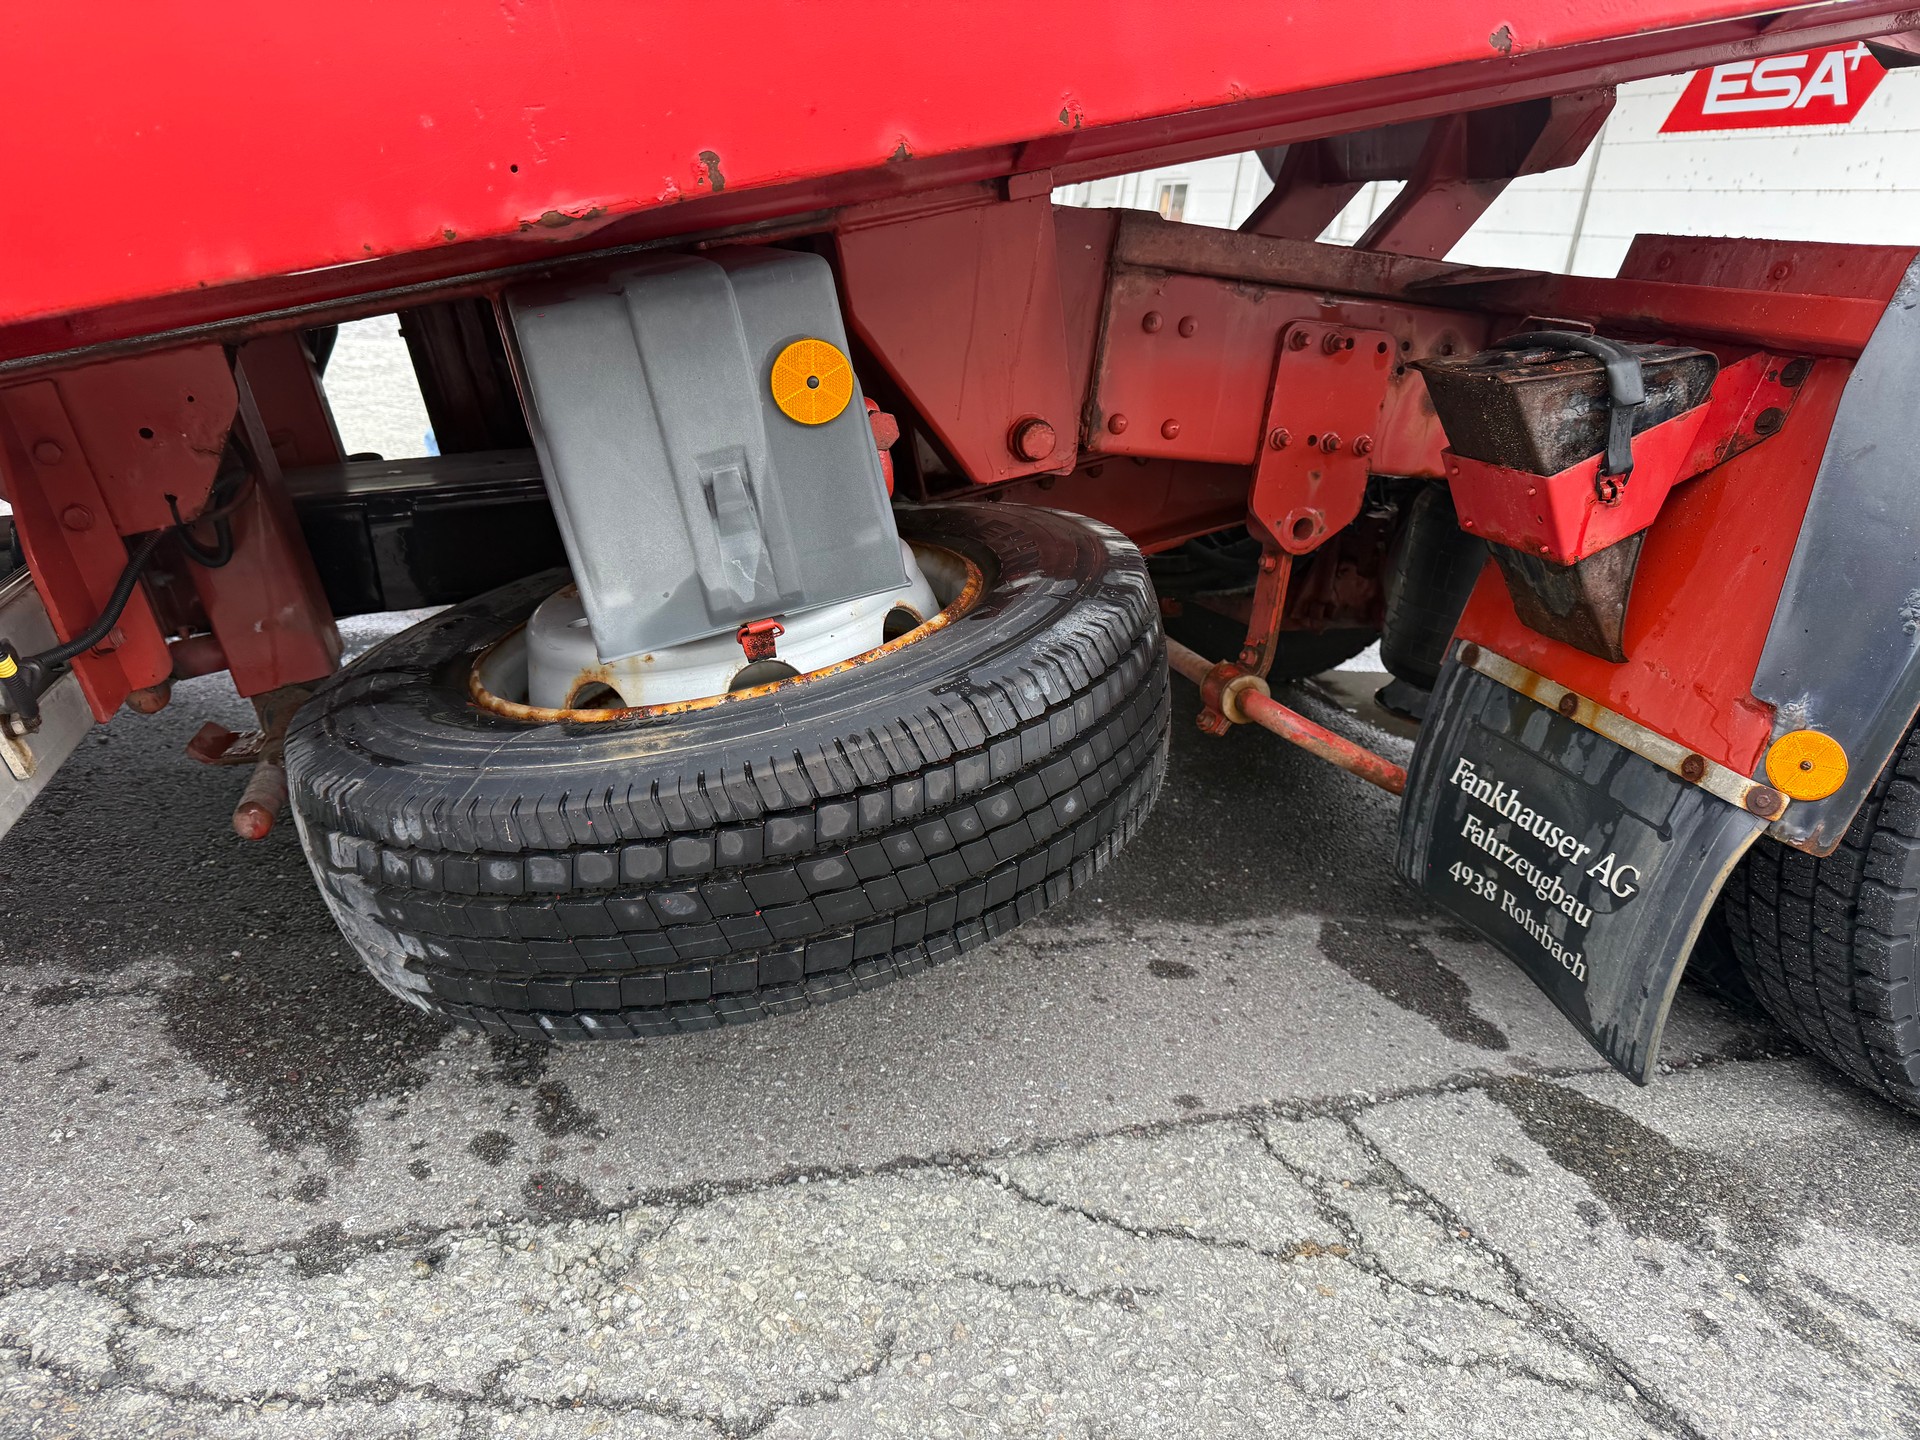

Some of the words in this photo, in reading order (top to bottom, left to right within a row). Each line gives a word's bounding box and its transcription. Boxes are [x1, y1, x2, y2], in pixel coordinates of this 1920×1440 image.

[1449, 757, 1591, 866] Fankhauser
[1586, 852, 1641, 899] AG
[1460, 813, 1595, 929] Fahrzeugbau
[1448, 860, 1498, 902] 4938
[1500, 889, 1589, 983] Rohrbach
